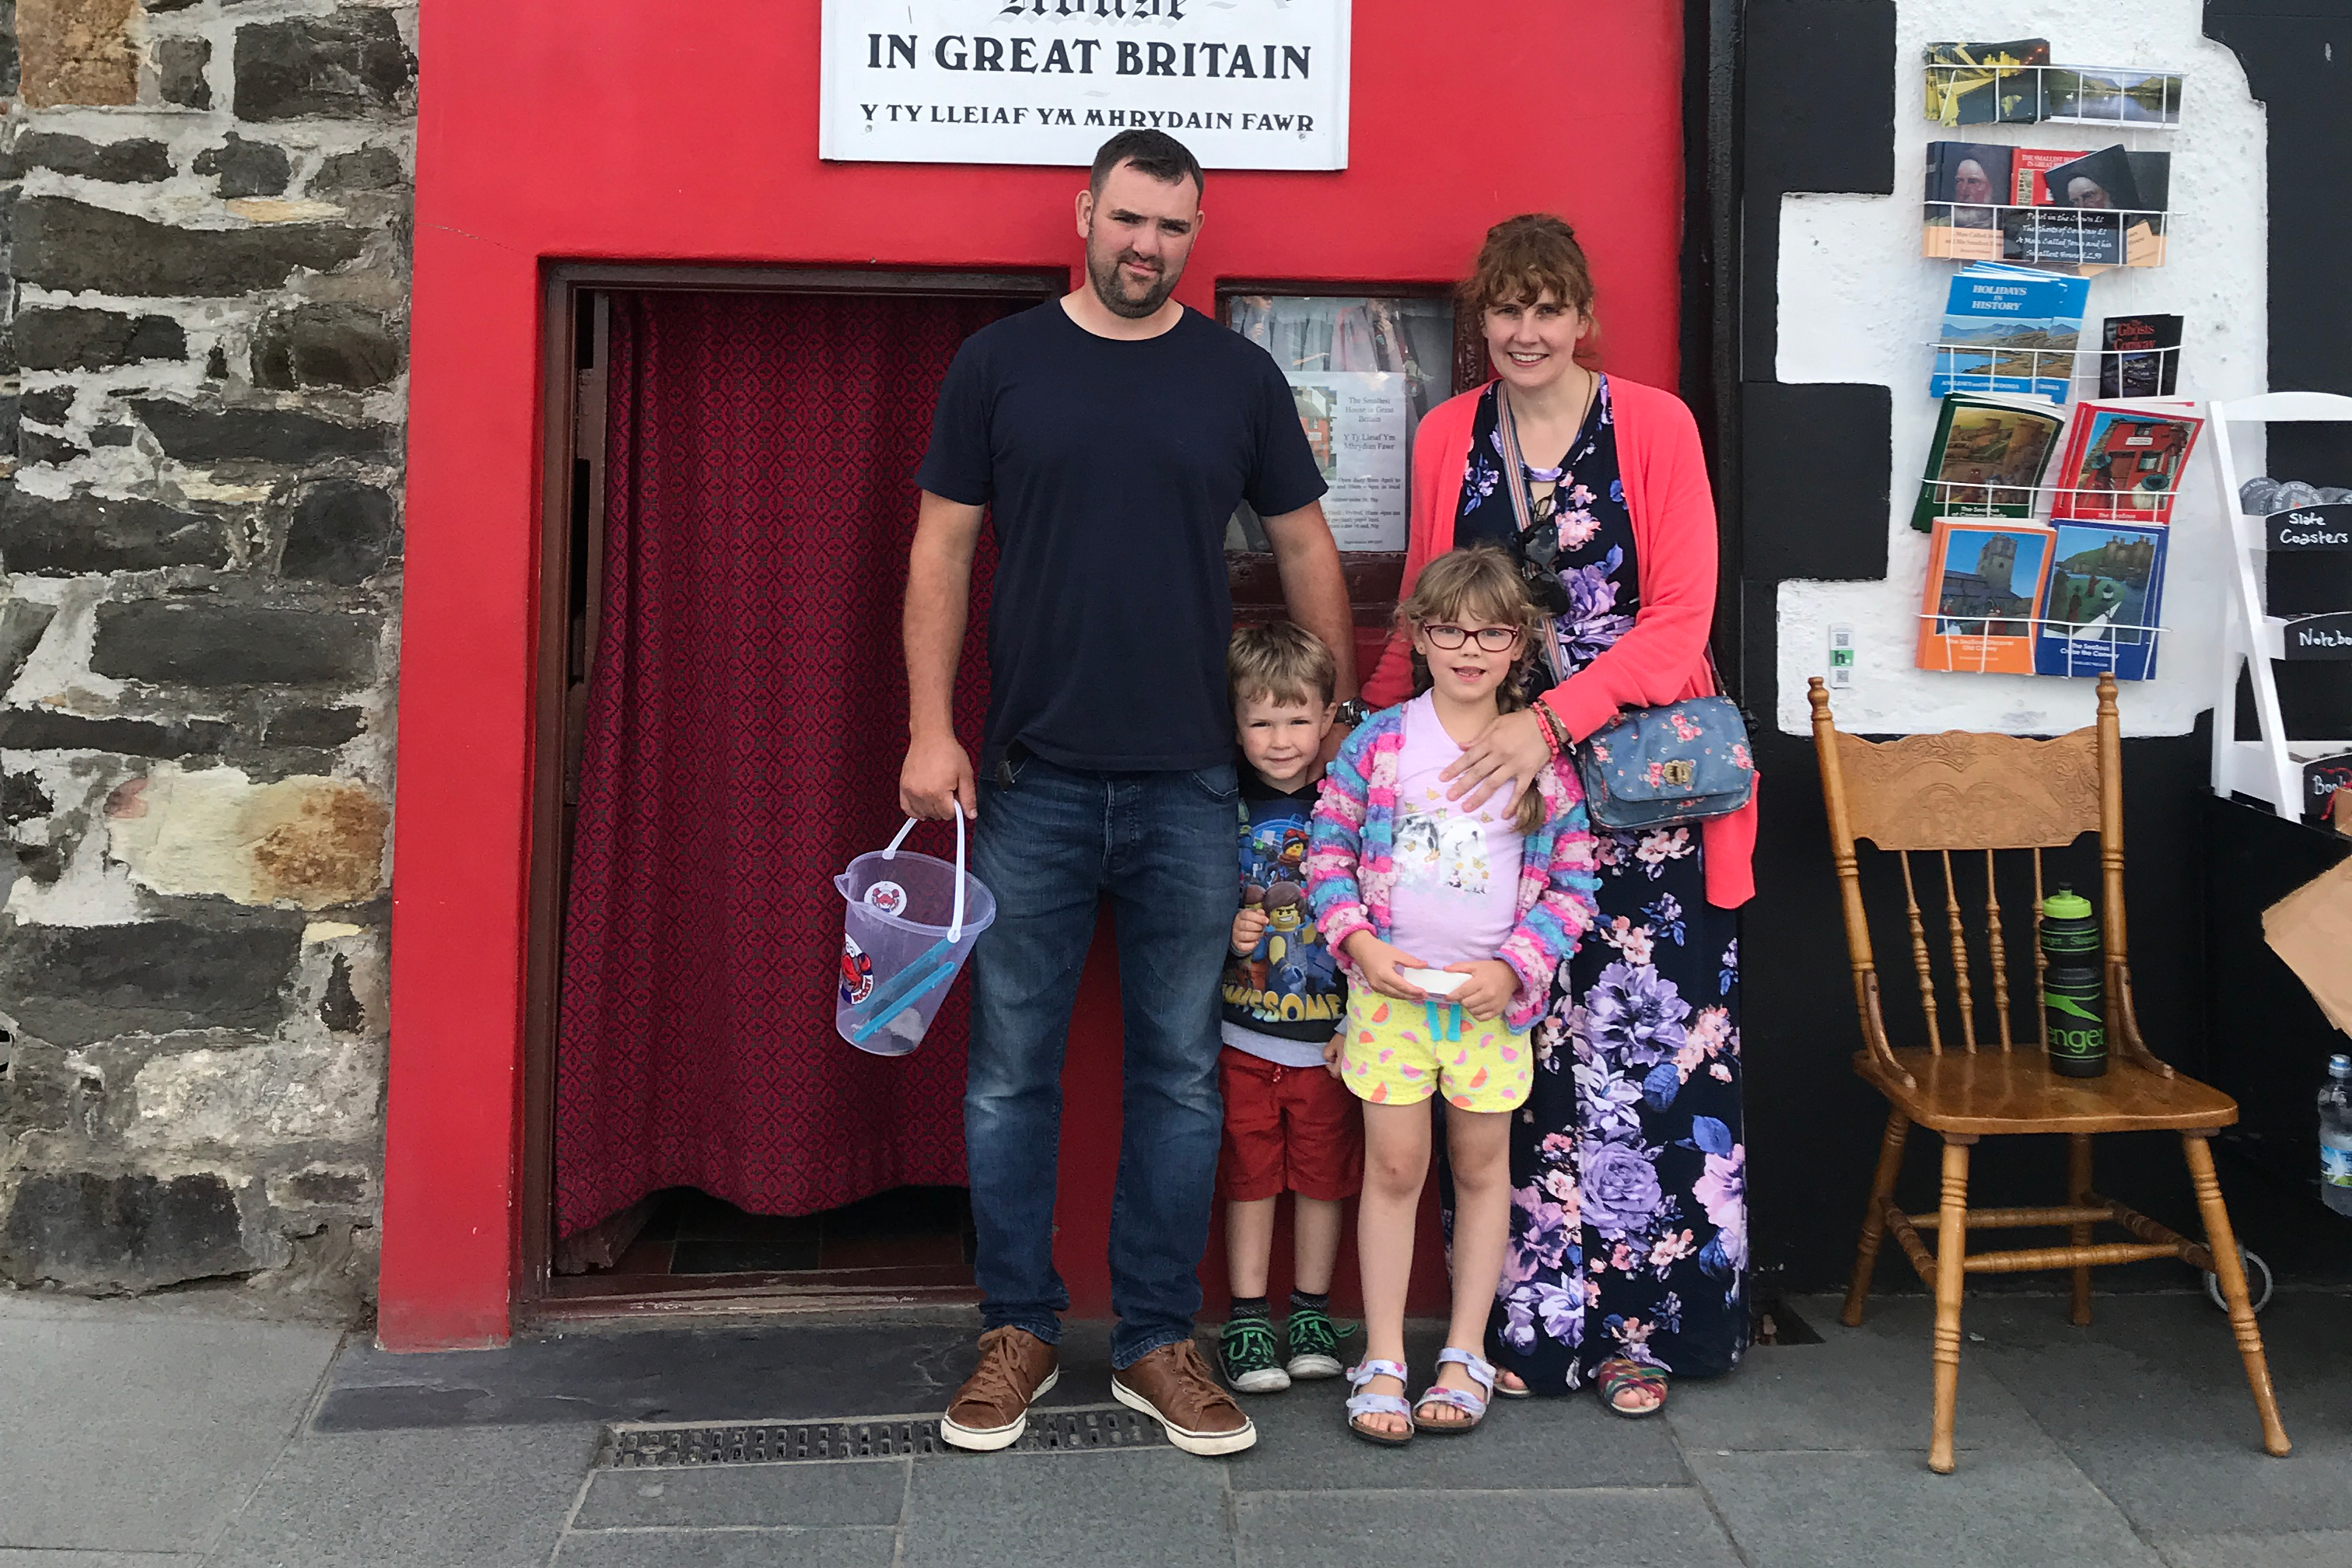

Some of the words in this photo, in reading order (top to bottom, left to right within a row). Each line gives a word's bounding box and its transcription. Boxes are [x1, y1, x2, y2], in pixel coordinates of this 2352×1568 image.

[867, 33, 918, 68] IN
[935, 35, 1101, 74] GREAT
[1116, 40, 1311, 79] BRITAIN
[860, 104, 878, 121] Y
[886, 104, 923, 121] TY
[931, 106, 1029, 124] LLEIAF
[1037, 108, 1076, 125] YM
[1083, 109, 1232, 129] MHRYDAIN
[1241, 114, 1314, 131] FAWR
[1972, 285, 2027, 296] HOLIDAYS
[1972, 301, 2022, 311] HISTORY
[2289, 512, 2326, 526] Slate
[2280, 528, 2349, 545] Coasters
[1222, 983, 1346, 1023] WESOME
